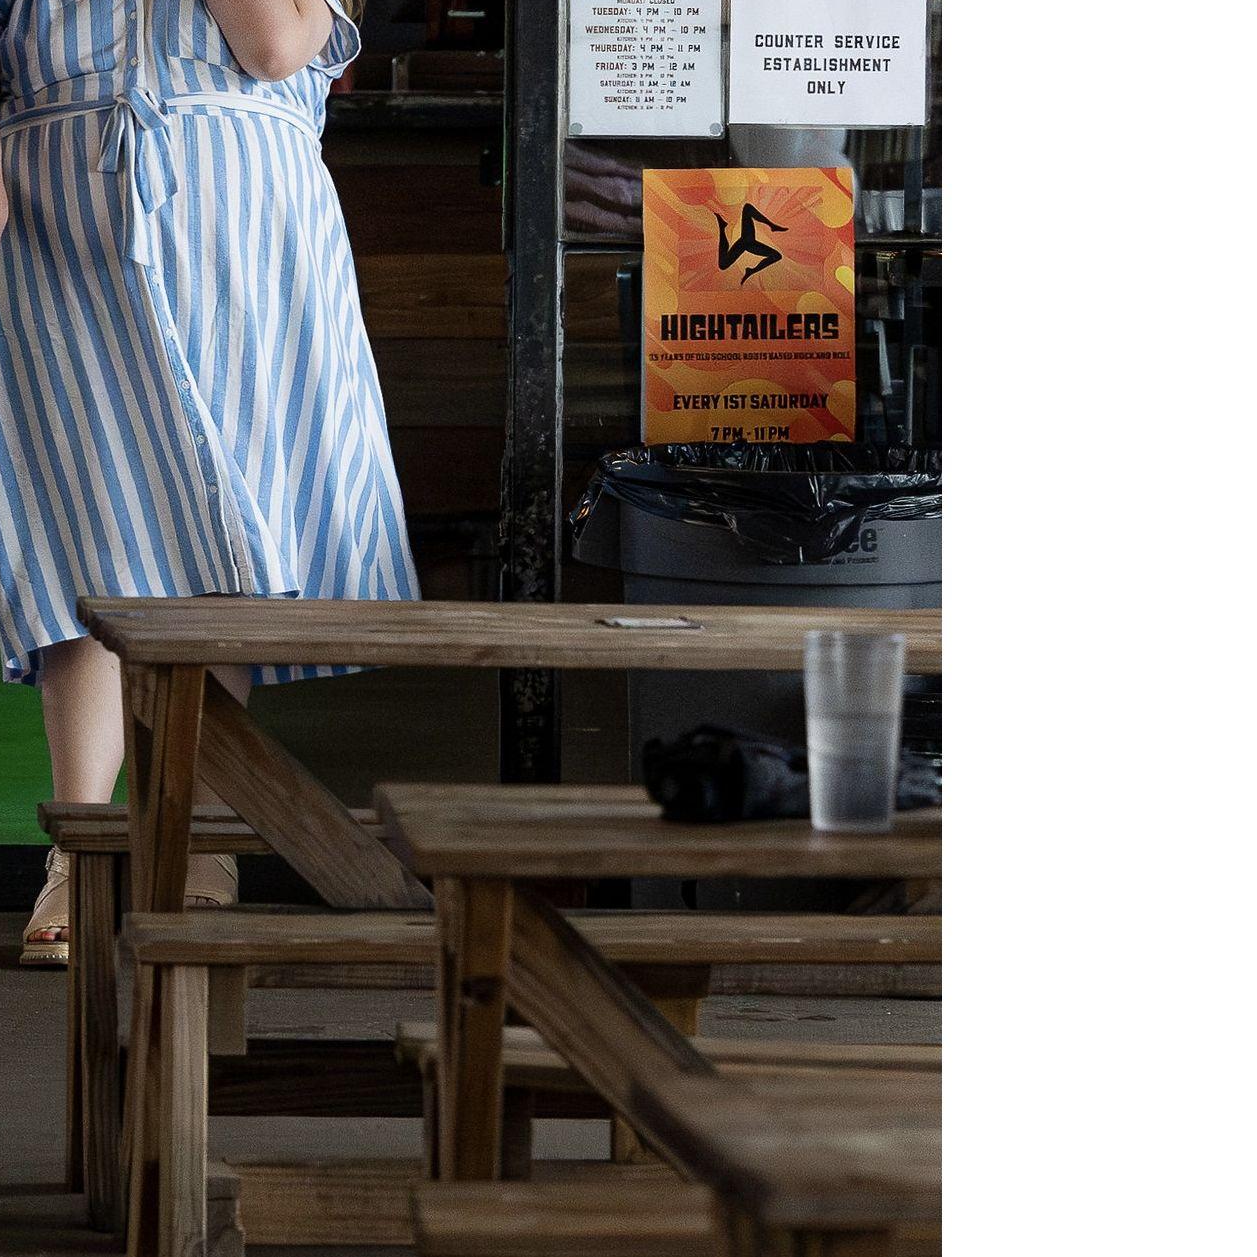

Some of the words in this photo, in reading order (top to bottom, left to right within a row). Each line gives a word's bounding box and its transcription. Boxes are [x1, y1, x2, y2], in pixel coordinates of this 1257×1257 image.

[585, 26, 638, 34] WEDNESDAY:
[643, 26, 648, 34] 4
[590, 44, 635, 52] THURSDAY:
[651, 44, 663, 52] PM
[755, 34, 824, 48] COUNTER
[834, 35, 901, 49] SERVICE
[595, 63, 627, 71] FRIDAY:
[763, 57, 891, 72] ESTABLISHMENT
[807, 81, 846, 95] ONLY
[661, 313, 839, 341] HIGHTAILERS
[661, 352, 684, 361] YEARS
[685, 352, 695, 360] OF
[696, 352, 711, 360] OLD
[711, 352, 741, 360] SCHOOL
[743, 352, 767, 360] ROOTS
[769, 352, 793, 360] BASED
[832, 351, 851, 359] ROLL
[673, 394, 721, 410] EVERY
[723, 394, 748, 409] 1ST
[750, 393, 829, 409] SATURDAY
[711, 427, 719, 441] 7
[722, 427, 743, 441] PM
[754, 427, 763, 440] 11
[768, 426, 790, 440] PM
